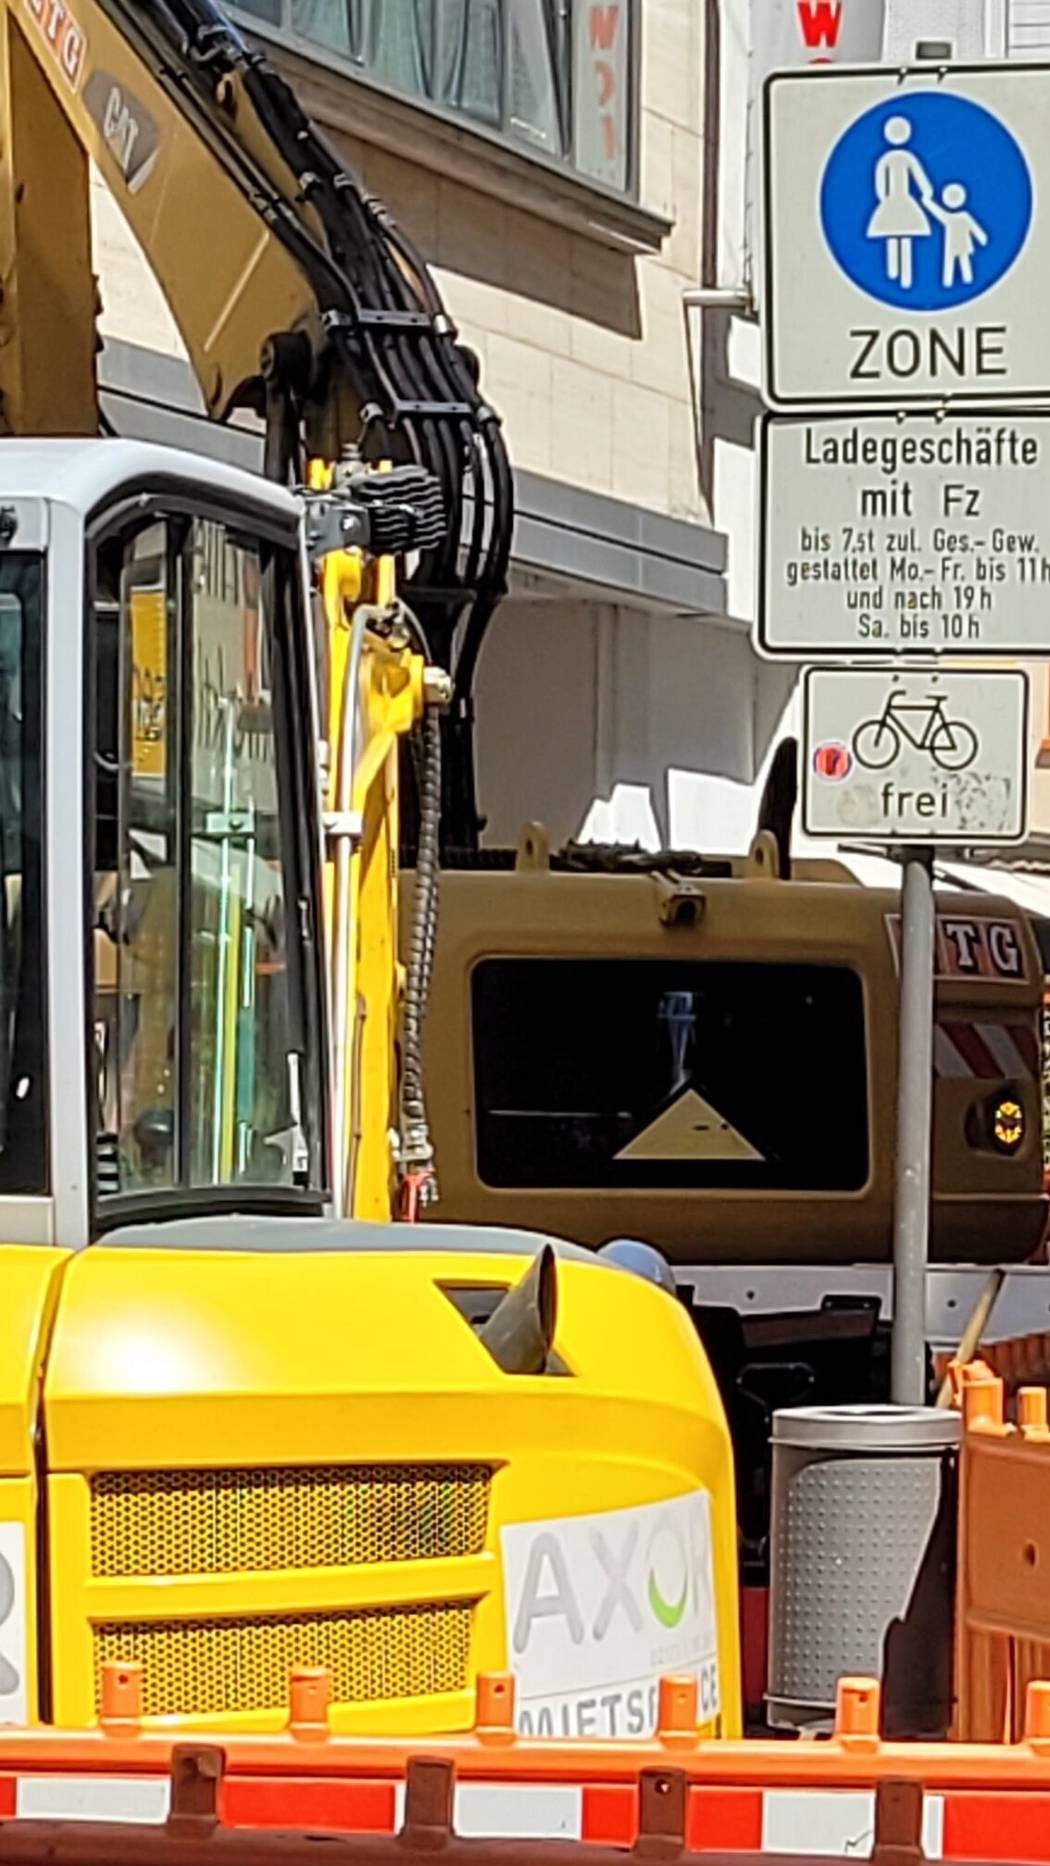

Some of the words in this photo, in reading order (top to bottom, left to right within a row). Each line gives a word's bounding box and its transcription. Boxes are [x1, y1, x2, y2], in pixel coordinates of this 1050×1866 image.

[849, 326, 1007, 379] ZONE
[804, 427, 1038, 475] Ladegeschäfte
[861, 479, 911, 517] mit
[943, 484, 980, 517] Fz
[801, 526, 830, 552] bis
[886, 528, 922, 552] zul.
[787, 557, 878, 587] gestattet
[975, 556, 1006, 582] bis
[847, 585, 883, 610] und
[894, 585, 943, 610] nach
[858, 613, 889, 638] Sa.
[900, 613, 929, 638] bis
[881, 782, 948, 817] frei
[940, 920, 1026, 978] TG
